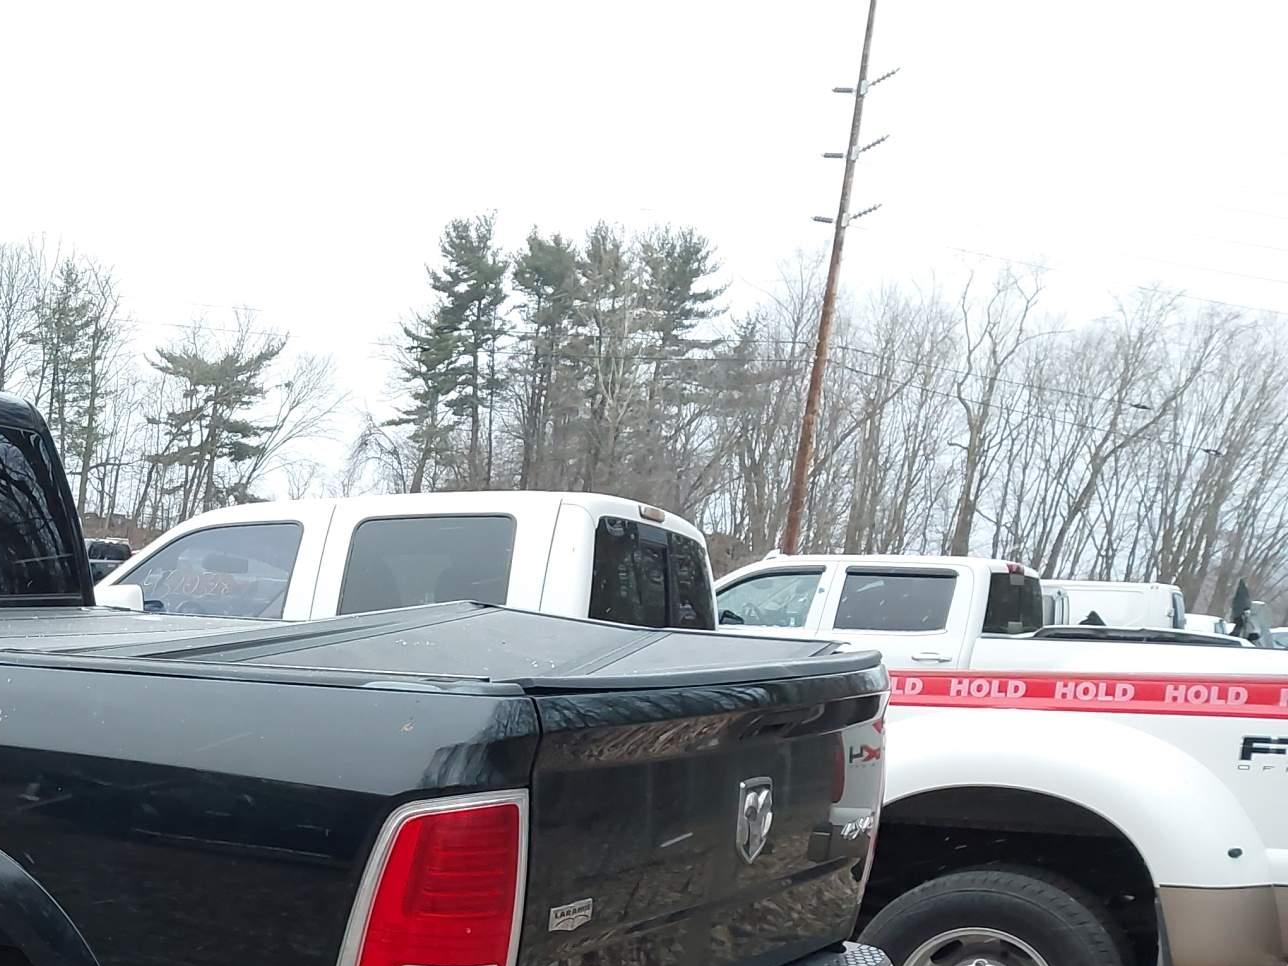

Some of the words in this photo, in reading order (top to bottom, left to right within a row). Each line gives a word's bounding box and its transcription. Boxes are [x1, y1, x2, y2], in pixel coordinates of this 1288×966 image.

[950, 678, 1026, 698] HOLD
[1054, 681, 1136, 702] HOLD
[1164, 684, 1249, 706] HOLD
